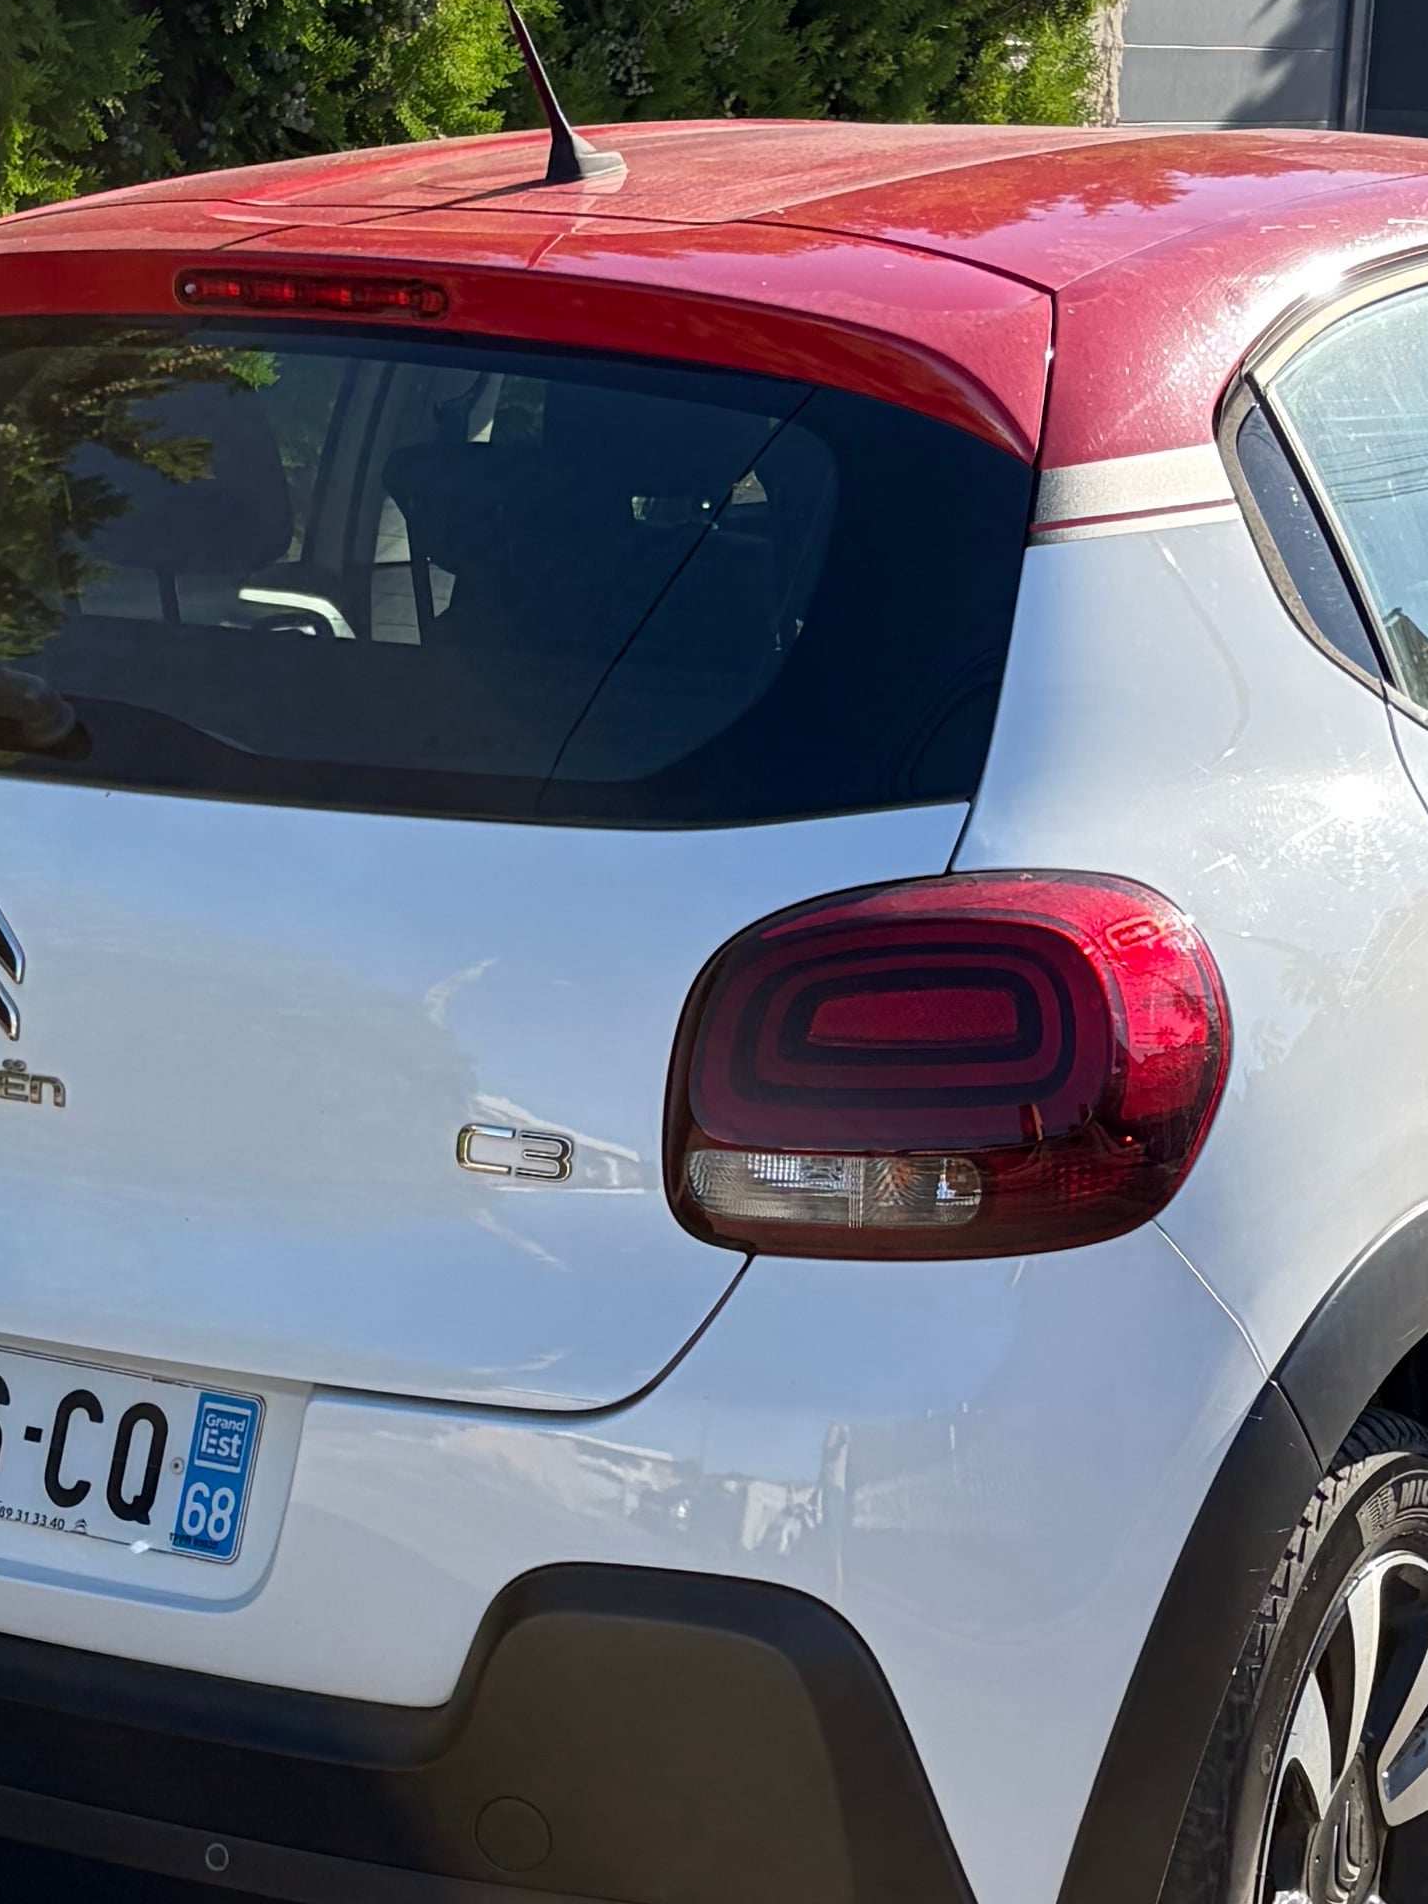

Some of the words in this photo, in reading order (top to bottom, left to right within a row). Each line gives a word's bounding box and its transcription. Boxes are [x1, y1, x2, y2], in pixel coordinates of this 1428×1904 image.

[455, 1122, 574, 1184] C3
[200, 1427, 243, 1459] Est
[205, 1413, 246, 1433] Grand
[181, 1481, 236, 1542] 68
